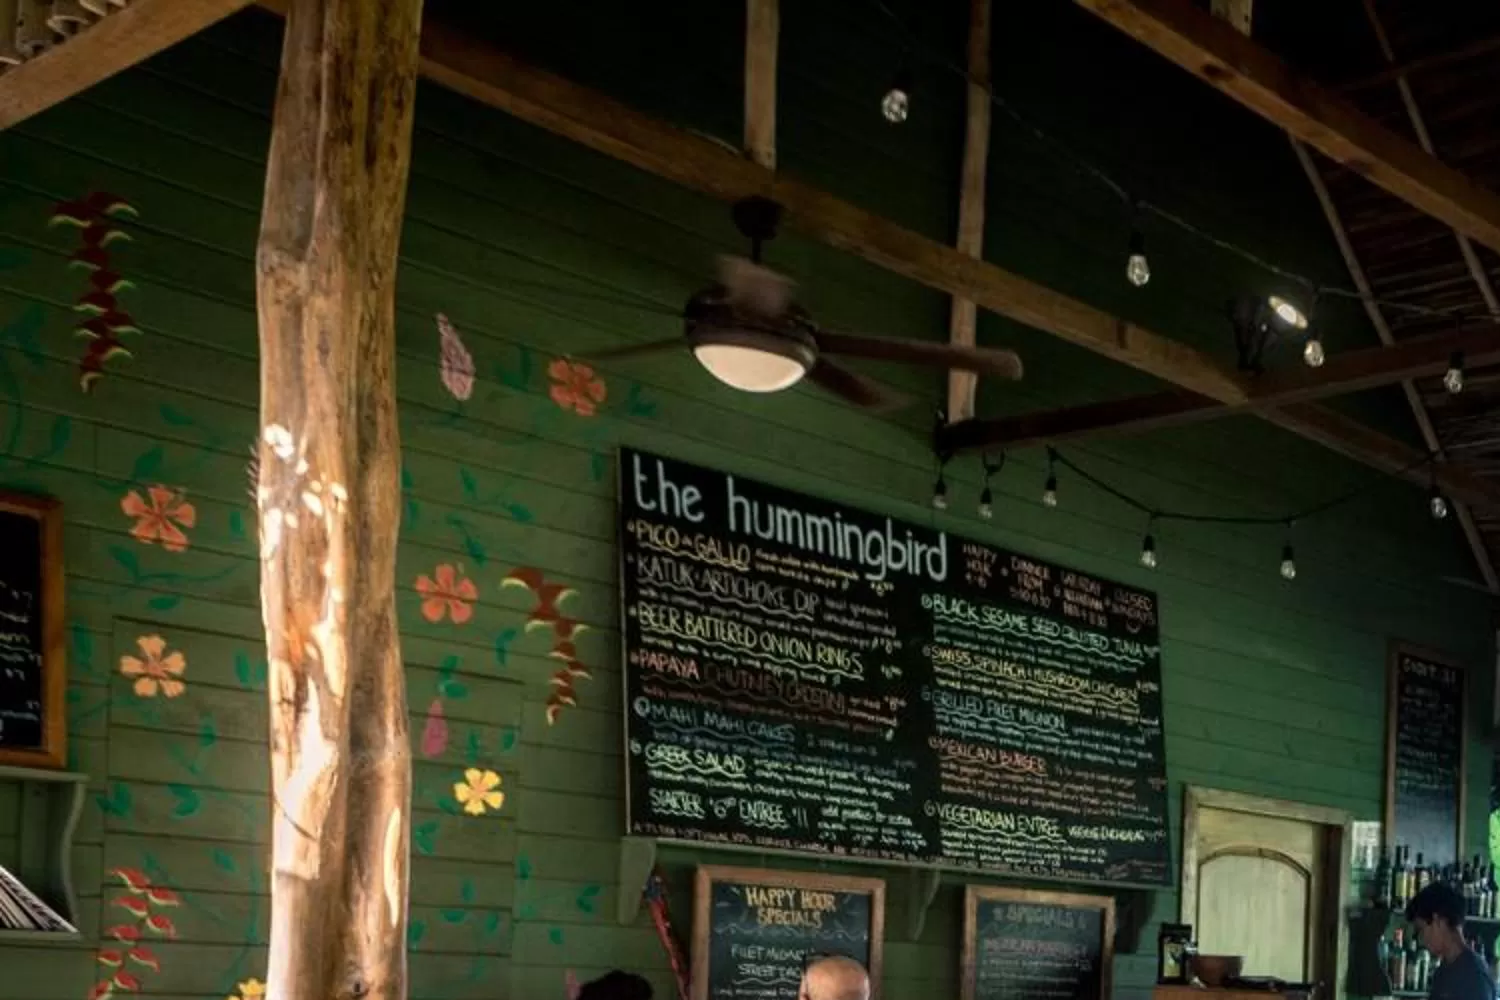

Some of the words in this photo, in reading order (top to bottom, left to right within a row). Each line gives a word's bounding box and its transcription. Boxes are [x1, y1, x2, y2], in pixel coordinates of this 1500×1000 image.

[633, 453, 705, 522] the
[727, 474, 947, 581] hummingbird
[933, 593, 978, 618] BLACK
[980, 605, 1029, 632] SESAME
[638, 601, 682, 630] BEER
[684, 611, 757, 649] BATTERED
[760, 632, 812, 661] ONION
[639, 649, 700, 682] PAPAYA
[693, 749, 746, 774] SALAD
[745, 886, 797, 907] HAPPY
[757, 906, 823, 929] SPECIALS
